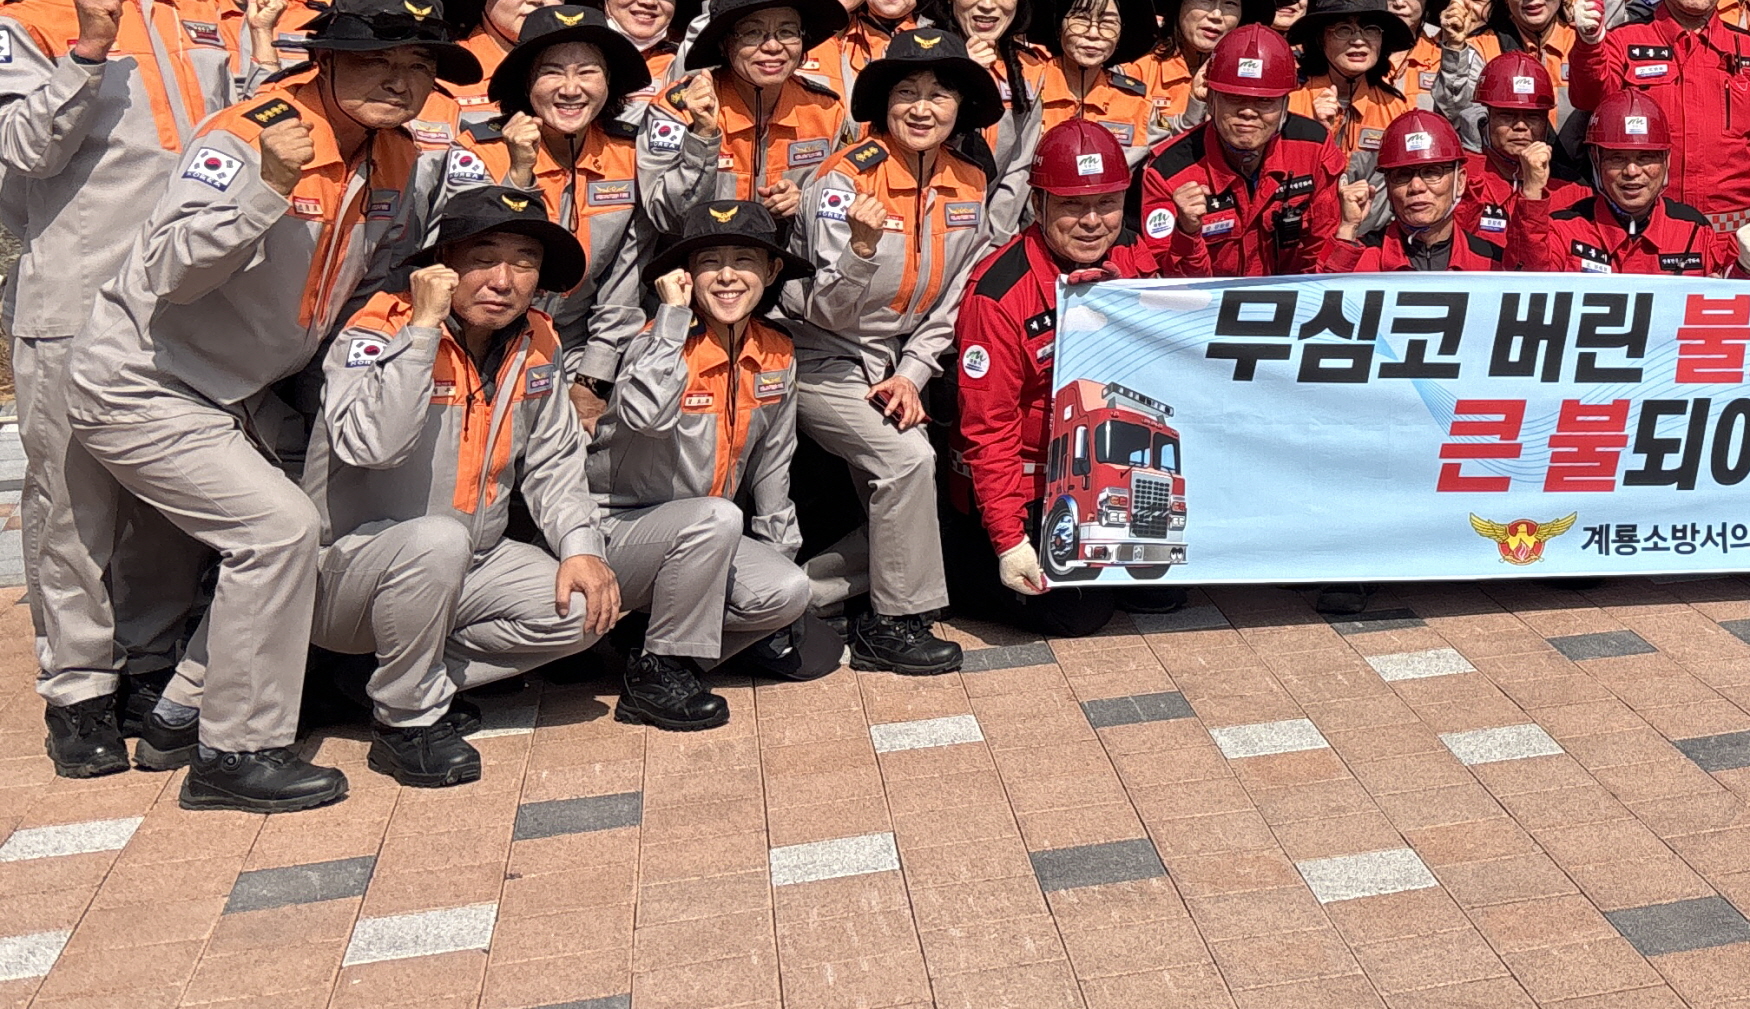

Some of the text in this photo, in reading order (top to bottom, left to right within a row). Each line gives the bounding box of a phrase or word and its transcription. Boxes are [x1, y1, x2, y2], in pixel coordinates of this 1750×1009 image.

[1206, 290, 1469, 383] 무심코
[1489, 291, 1654, 383] 버린
[1438, 399, 1526, 492] 큰
